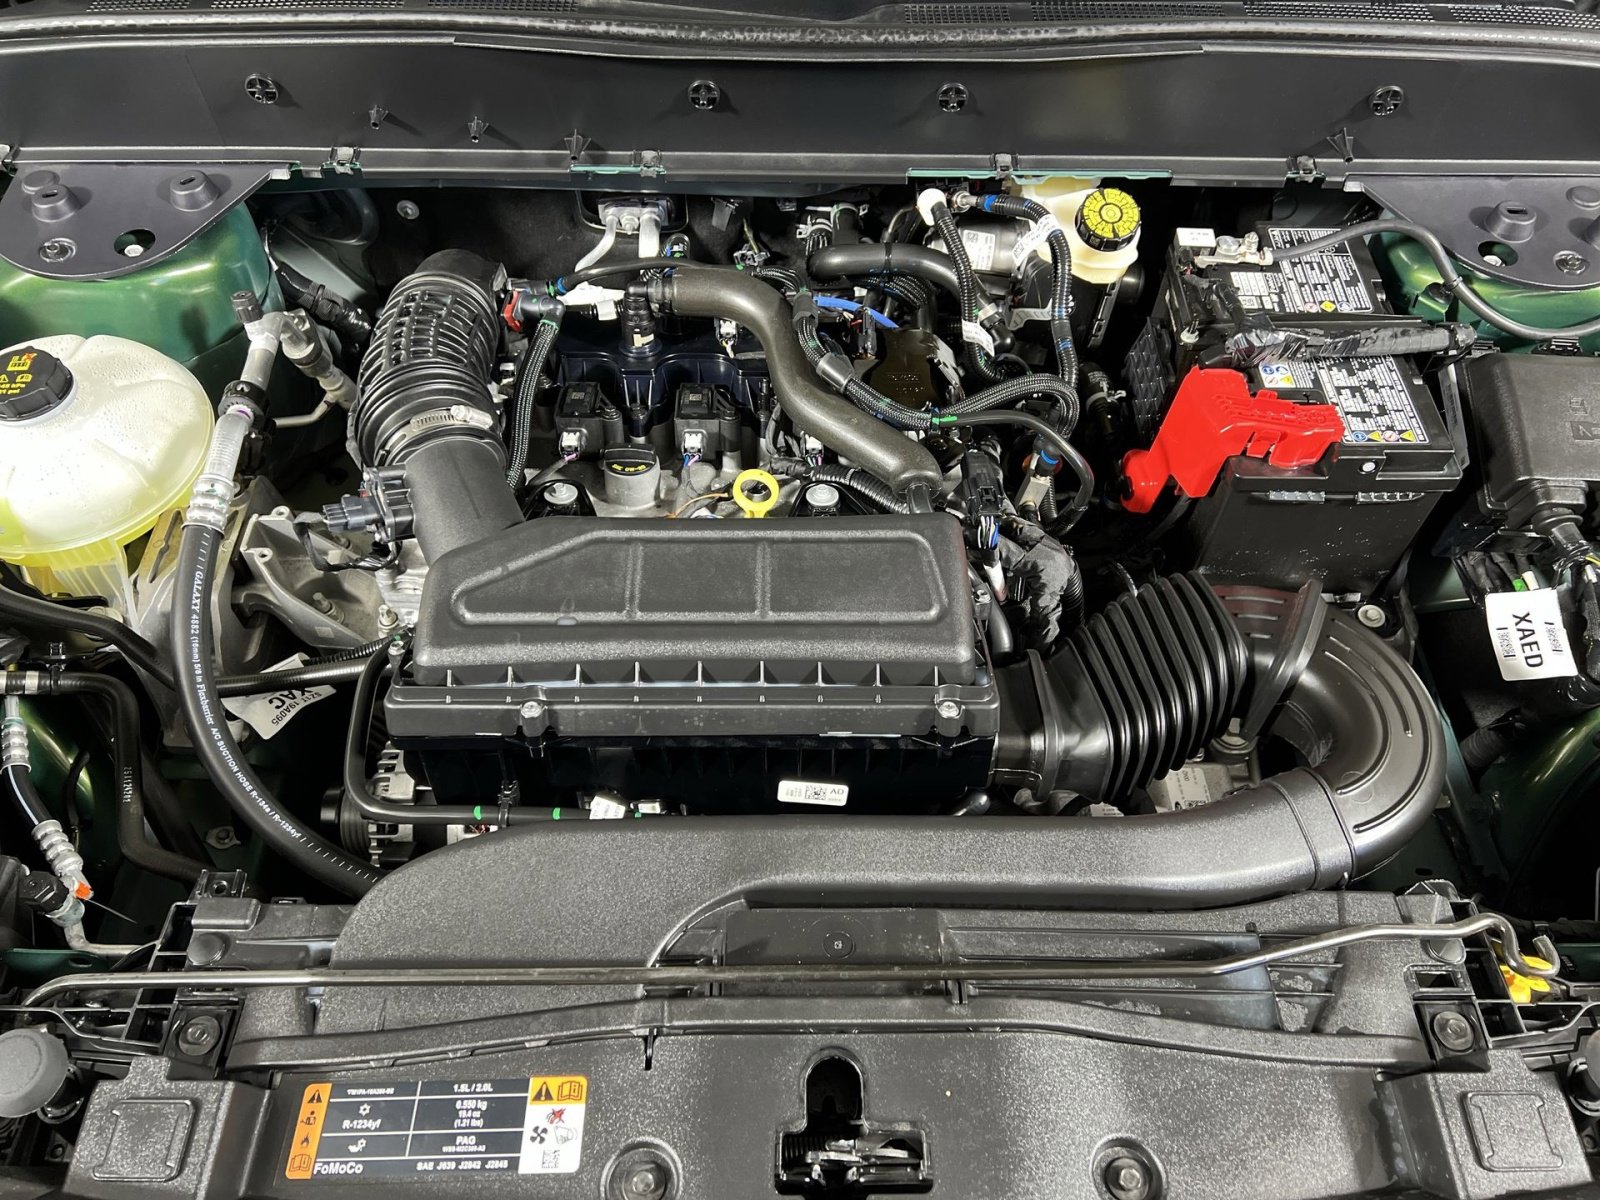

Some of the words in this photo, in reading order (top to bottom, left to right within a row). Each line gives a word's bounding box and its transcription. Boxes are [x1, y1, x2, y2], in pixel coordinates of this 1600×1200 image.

[191, 571, 204, 613] GALAXY
[190, 614, 201, 635] 4882
[190, 636, 201, 663] (16mm)
[1511, 611, 1544, 668] XAED
[271, 700, 300, 727] 19A095
[210, 727, 221, 740] A/C
[217, 740, 239, 773] SUCTION
[235, 771, 253, 792] HOSE
[249, 790, 271, 813] R-134a
[272, 813, 302, 839] R-1234yf
[453, 1083, 470, 1092] 1.5L
[475, 1083, 493, 1092] 2.0L
[455, 1100, 476, 1109] 0.550
[477, 1099, 487, 1110] kg
[342, 1119, 381, 1131] R-1234yf
[456, 1135, 476, 1145] PAG
[313, 1162, 363, 1174] FoMoCo
[416, 1161, 434, 1171] SAE
[436, 1161, 456, 1170] J639
